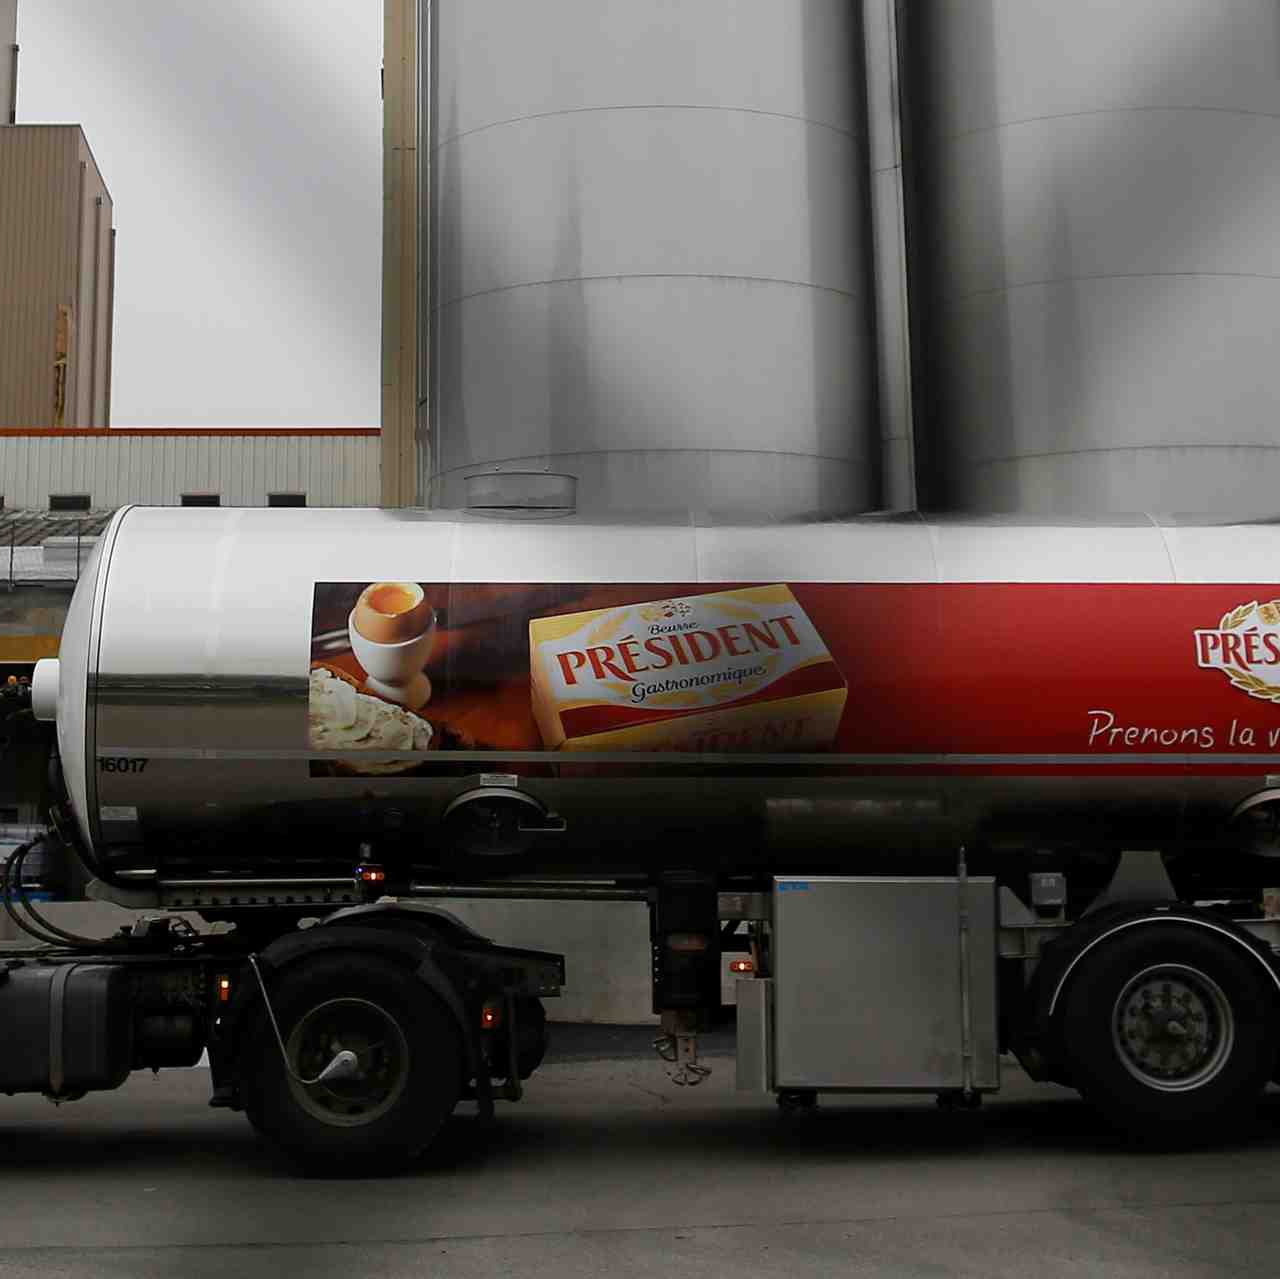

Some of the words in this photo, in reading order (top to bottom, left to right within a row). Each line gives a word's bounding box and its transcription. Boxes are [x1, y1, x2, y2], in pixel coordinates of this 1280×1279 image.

[648, 621, 699, 635] Beurre
[557, 616, 801, 685] PRÉSIDENT
[631, 664, 767, 703] Gastronomique
[1088, 710, 1214, 749] Prenons
[1229, 719, 1256, 747] la
[97, 757, 148, 773] 16017
